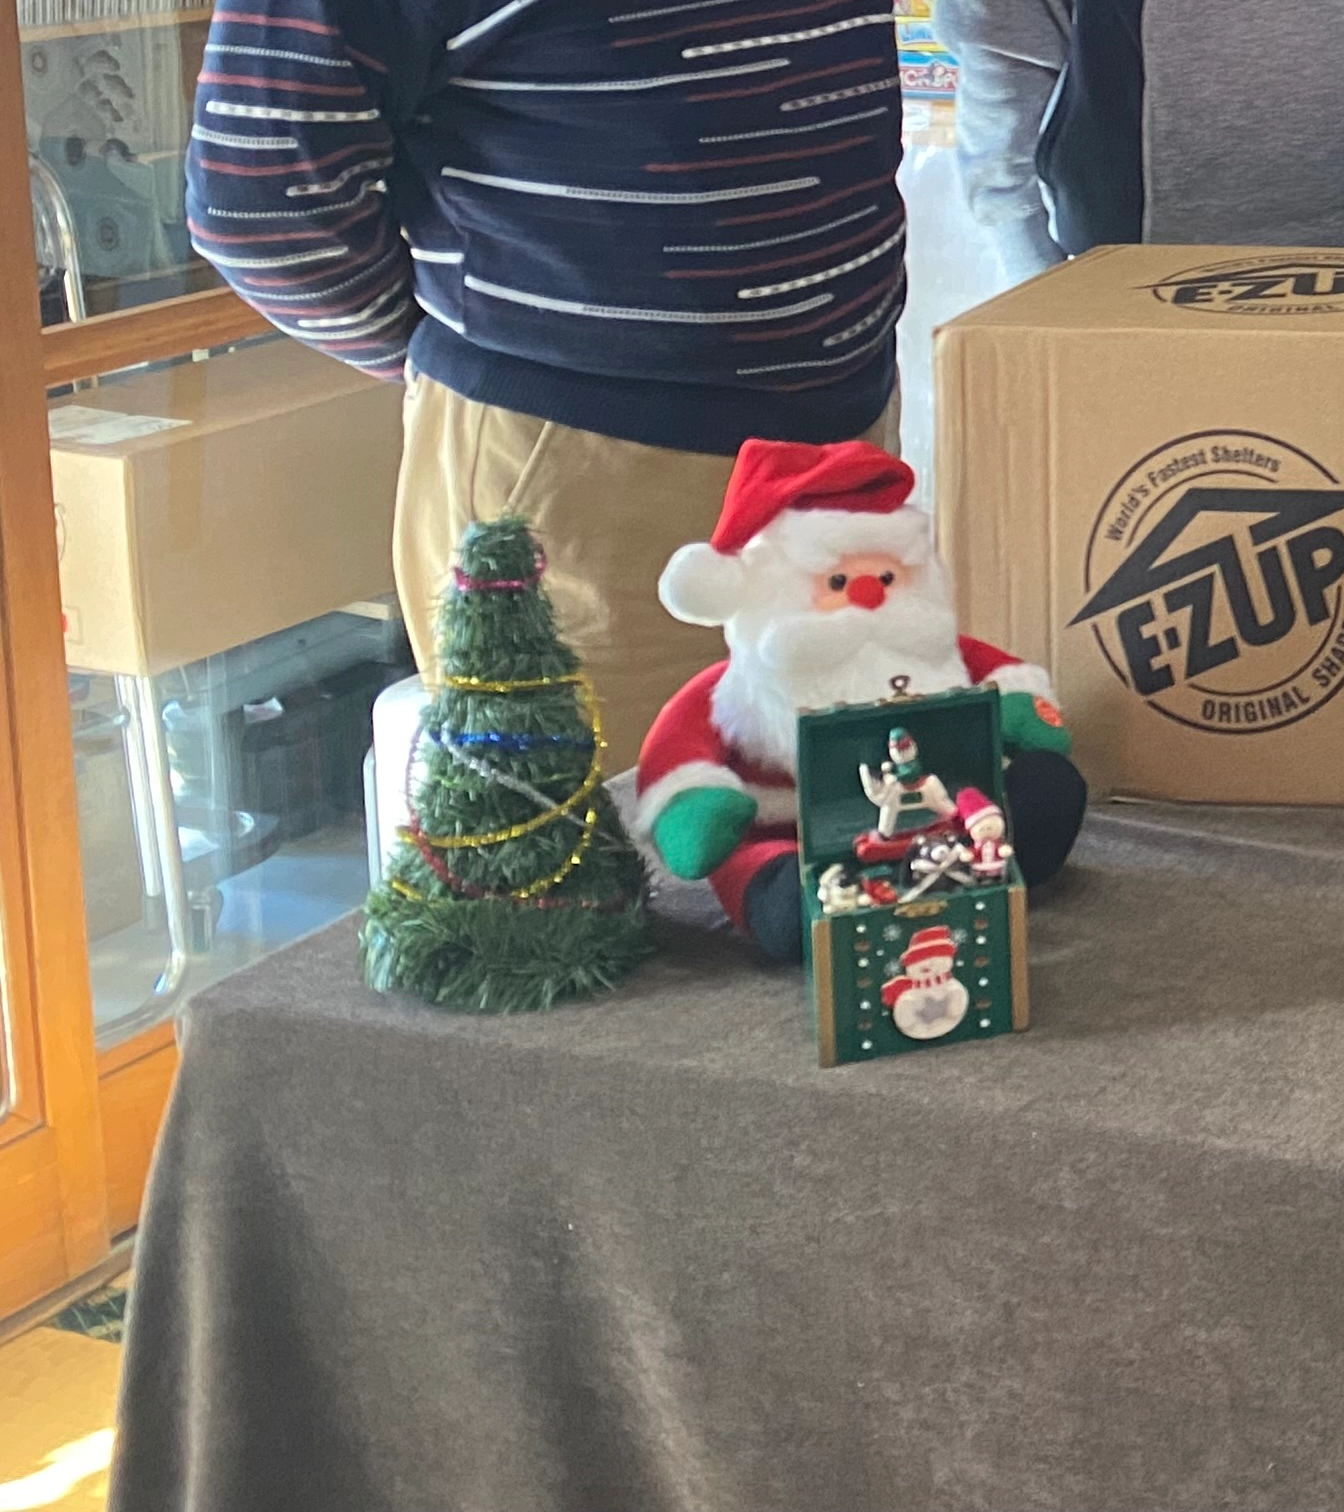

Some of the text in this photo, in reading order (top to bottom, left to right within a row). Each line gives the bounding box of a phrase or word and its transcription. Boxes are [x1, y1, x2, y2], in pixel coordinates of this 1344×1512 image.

[1104, 445, 1281, 542] World's Fastest Shelters
[1201, 686, 1311, 724] ORIGINAL
